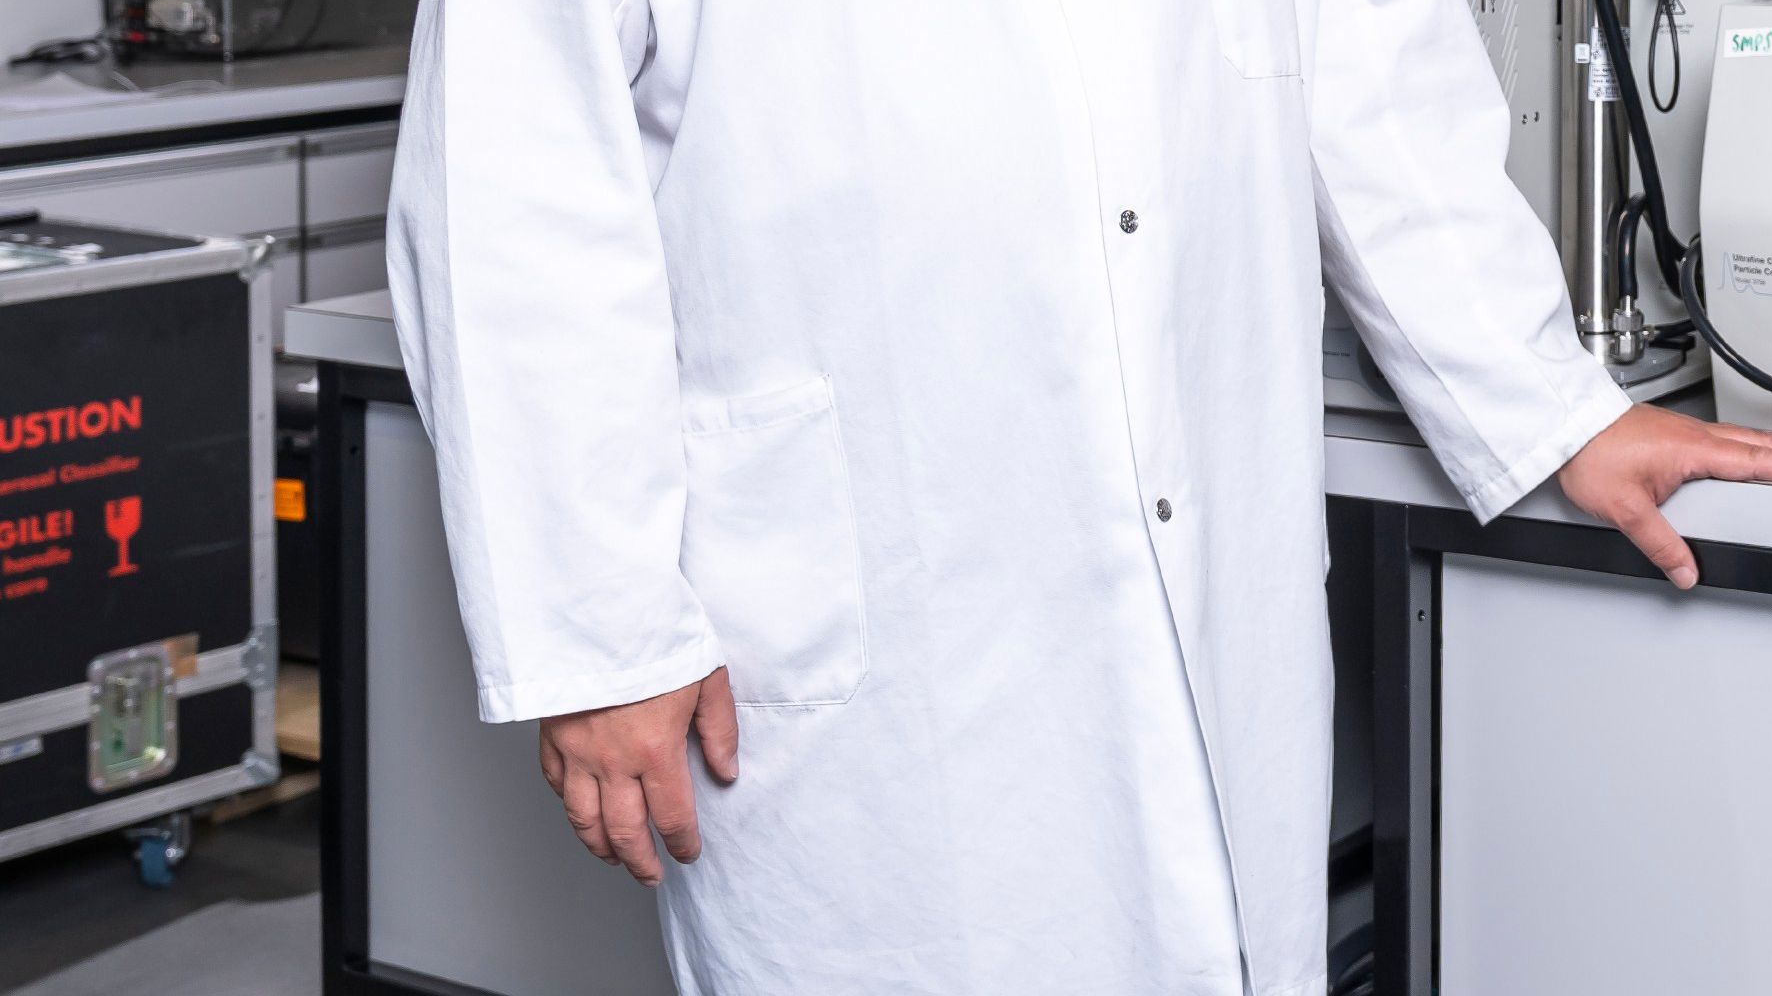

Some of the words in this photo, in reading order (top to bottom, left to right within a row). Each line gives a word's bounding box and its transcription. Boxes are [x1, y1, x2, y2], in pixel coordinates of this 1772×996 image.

[1732, 253, 1765, 265] Ultrafine
[1733, 264, 1762, 275] Particle
[0, 395, 142, 452] USTION
